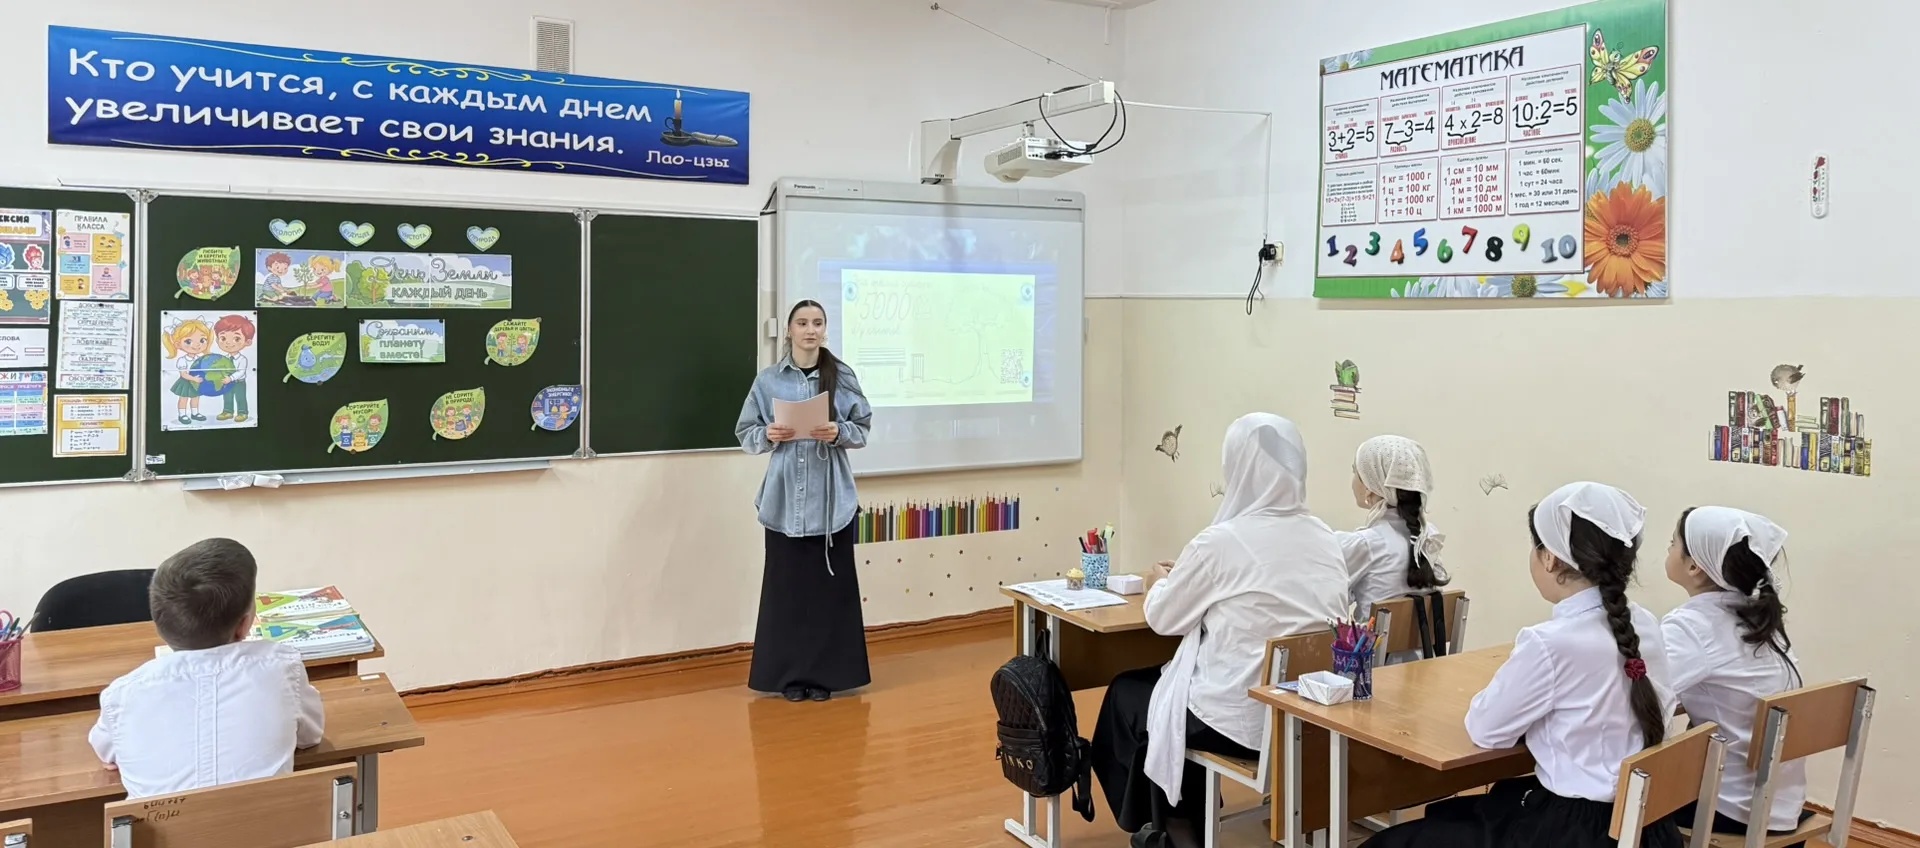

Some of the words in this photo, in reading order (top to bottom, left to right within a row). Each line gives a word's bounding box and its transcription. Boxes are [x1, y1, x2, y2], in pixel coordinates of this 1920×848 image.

[1380, 45, 1524, 90] МАТЕМАТИКА
[70, 49, 155, 81] Кто
[171, 66, 336, 100] учится,
[353, 81, 372, 98] с
[390, 80, 547, 113] каждым
[560, 99, 651, 122] днем
[65, 92, 364, 135] увеличивает
[380, 120, 472, 142] свои
[489, 127, 623, 154] знания.
[1328, 125, 1374, 147] 3+2=5
[646, 150, 729, 167] Лао-цзы
[1327, 235, 1339, 257] 1
[1343, 244, 1358, 267] 2
[1365, 231, 1381, 256] 3
[1390, 238, 1405, 265] 4
[1413, 227, 1428, 256] 5
[1436, 238, 1453, 264] 6
[1461, 225, 1478, 255] 7
[1485, 236, 1504, 262] 8
[1512, 223, 1531, 252] 9
[1540, 234, 1577, 263] 10
[391, 285, 452, 300] КАЖДЫЙ
[454, 287, 488, 300] ДЕНЬ
[380, 340, 425, 349] планету
[380, 350, 424, 359] вместе!
